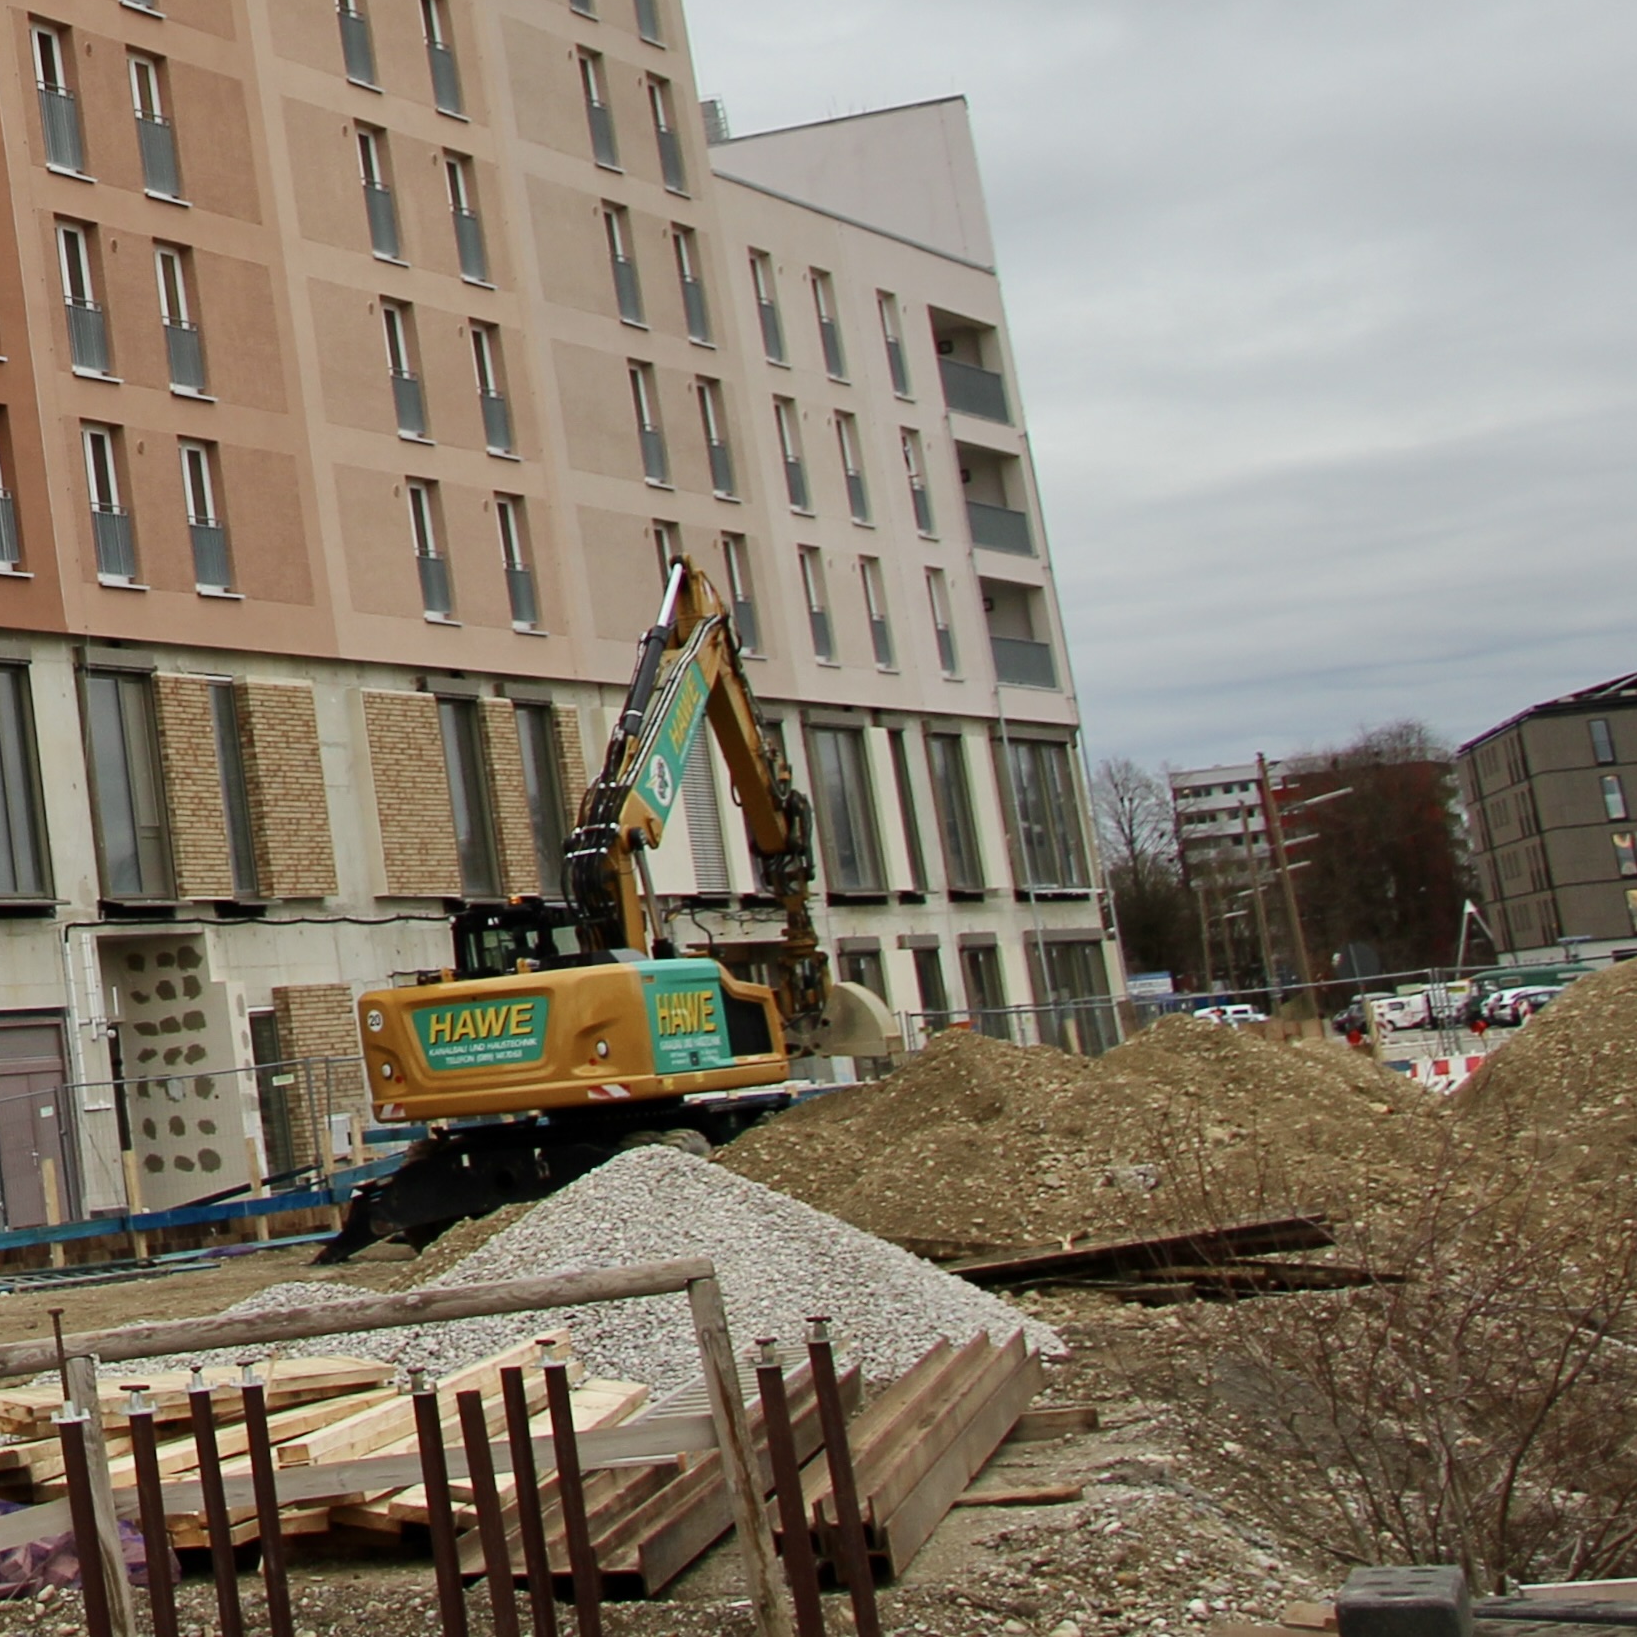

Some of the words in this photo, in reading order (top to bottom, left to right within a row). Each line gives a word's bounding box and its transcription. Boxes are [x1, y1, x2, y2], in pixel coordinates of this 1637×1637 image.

[669, 670, 702, 755] HAWE
[369, 1013, 381, 1026] 20
[429, 1003, 534, 1044] HAWE
[656, 990, 718, 1037] HAWE
[429, 1045, 468, 1056] KANALBAU
[469, 1043, 486, 1052] UND
[487, 1038, 537, 1050] HAUSTECHNIK
[446, 1055, 475, 1065] TELEFON
